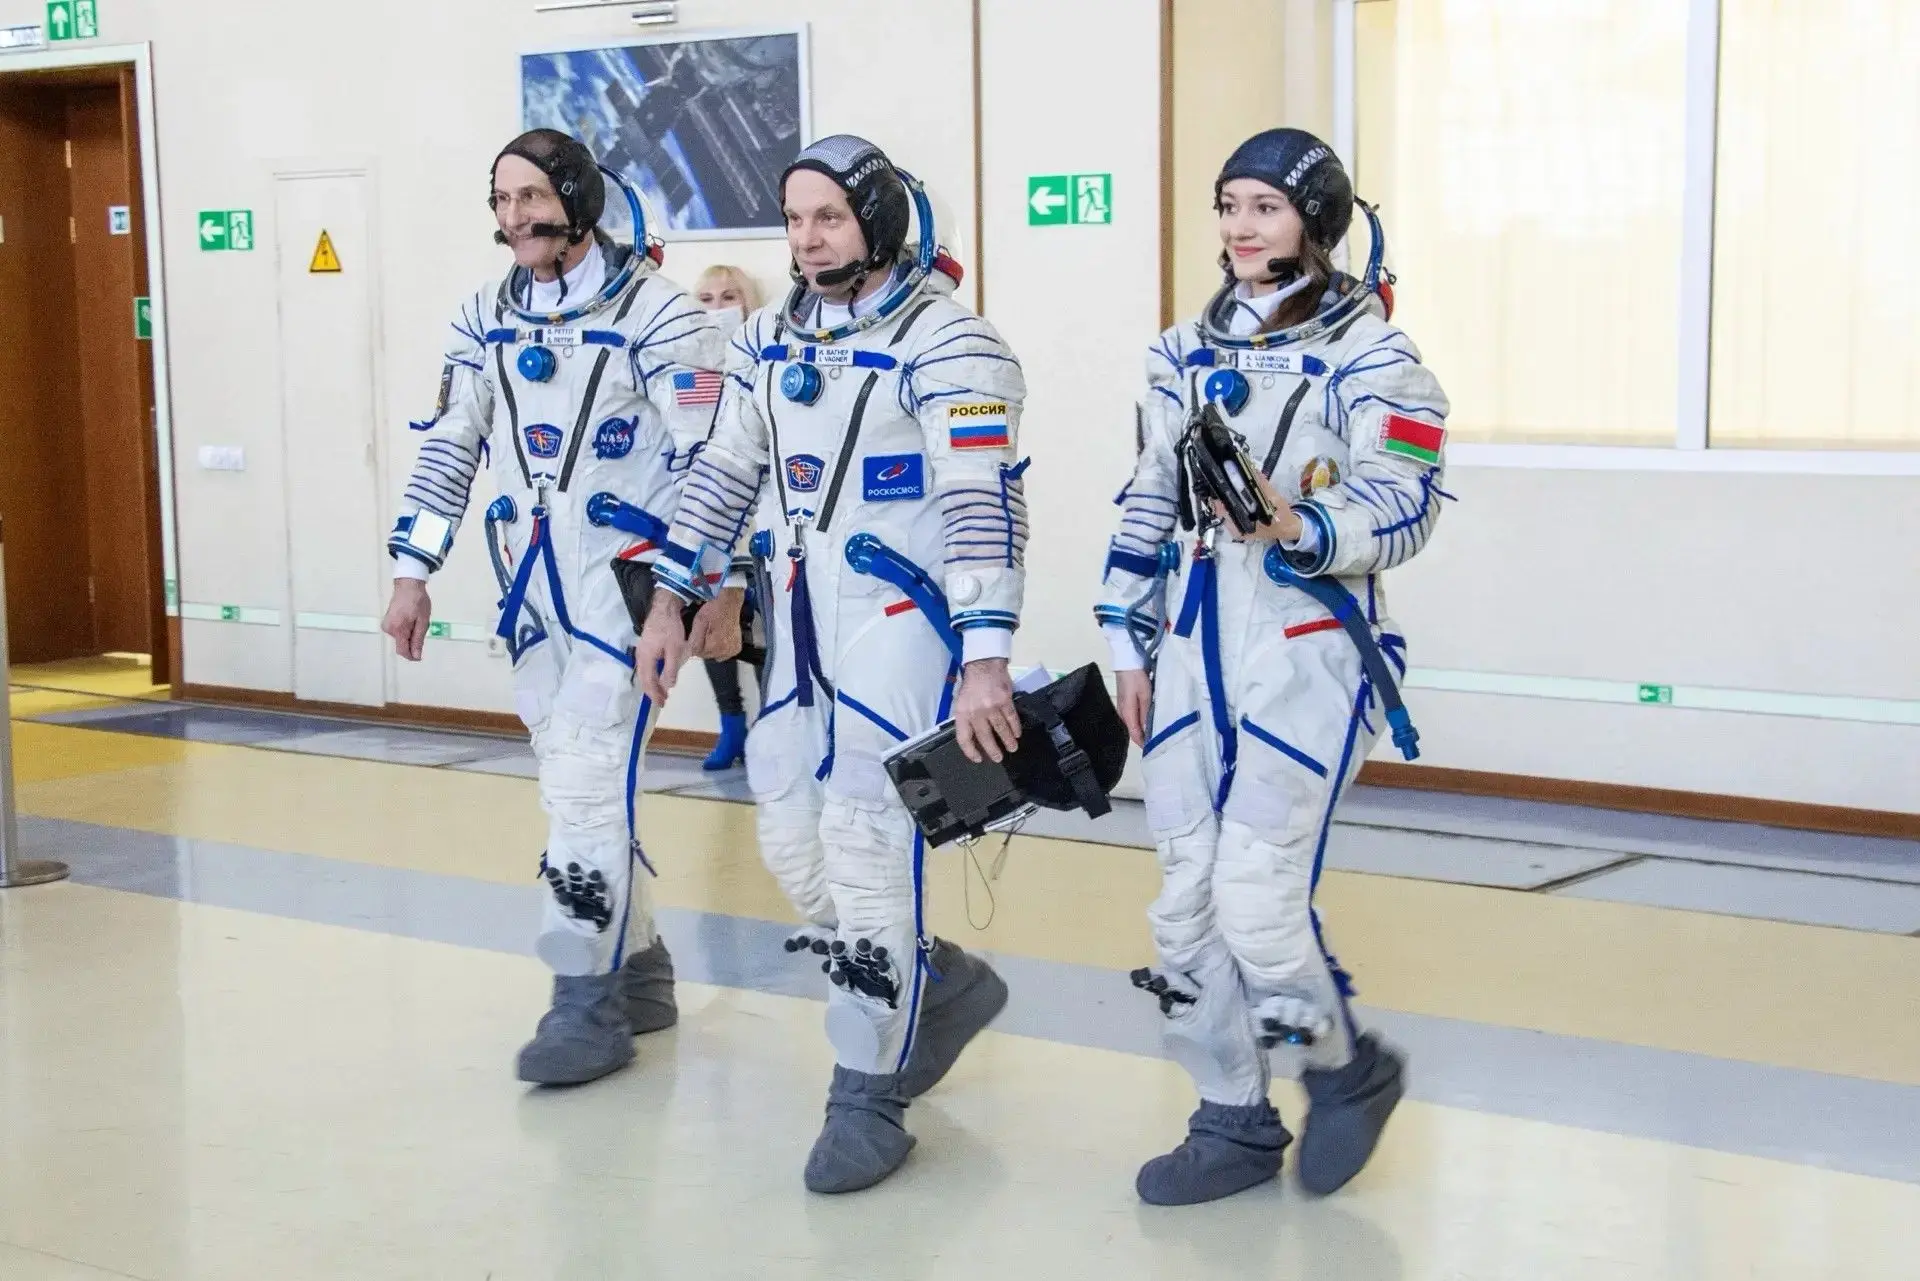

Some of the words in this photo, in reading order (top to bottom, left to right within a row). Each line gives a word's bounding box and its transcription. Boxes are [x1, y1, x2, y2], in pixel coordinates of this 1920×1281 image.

[950, 404, 1006, 417] РОССИЯ
[600, 433, 630, 447] NASA
[867, 486, 920, 496] РОСКОСМОС
